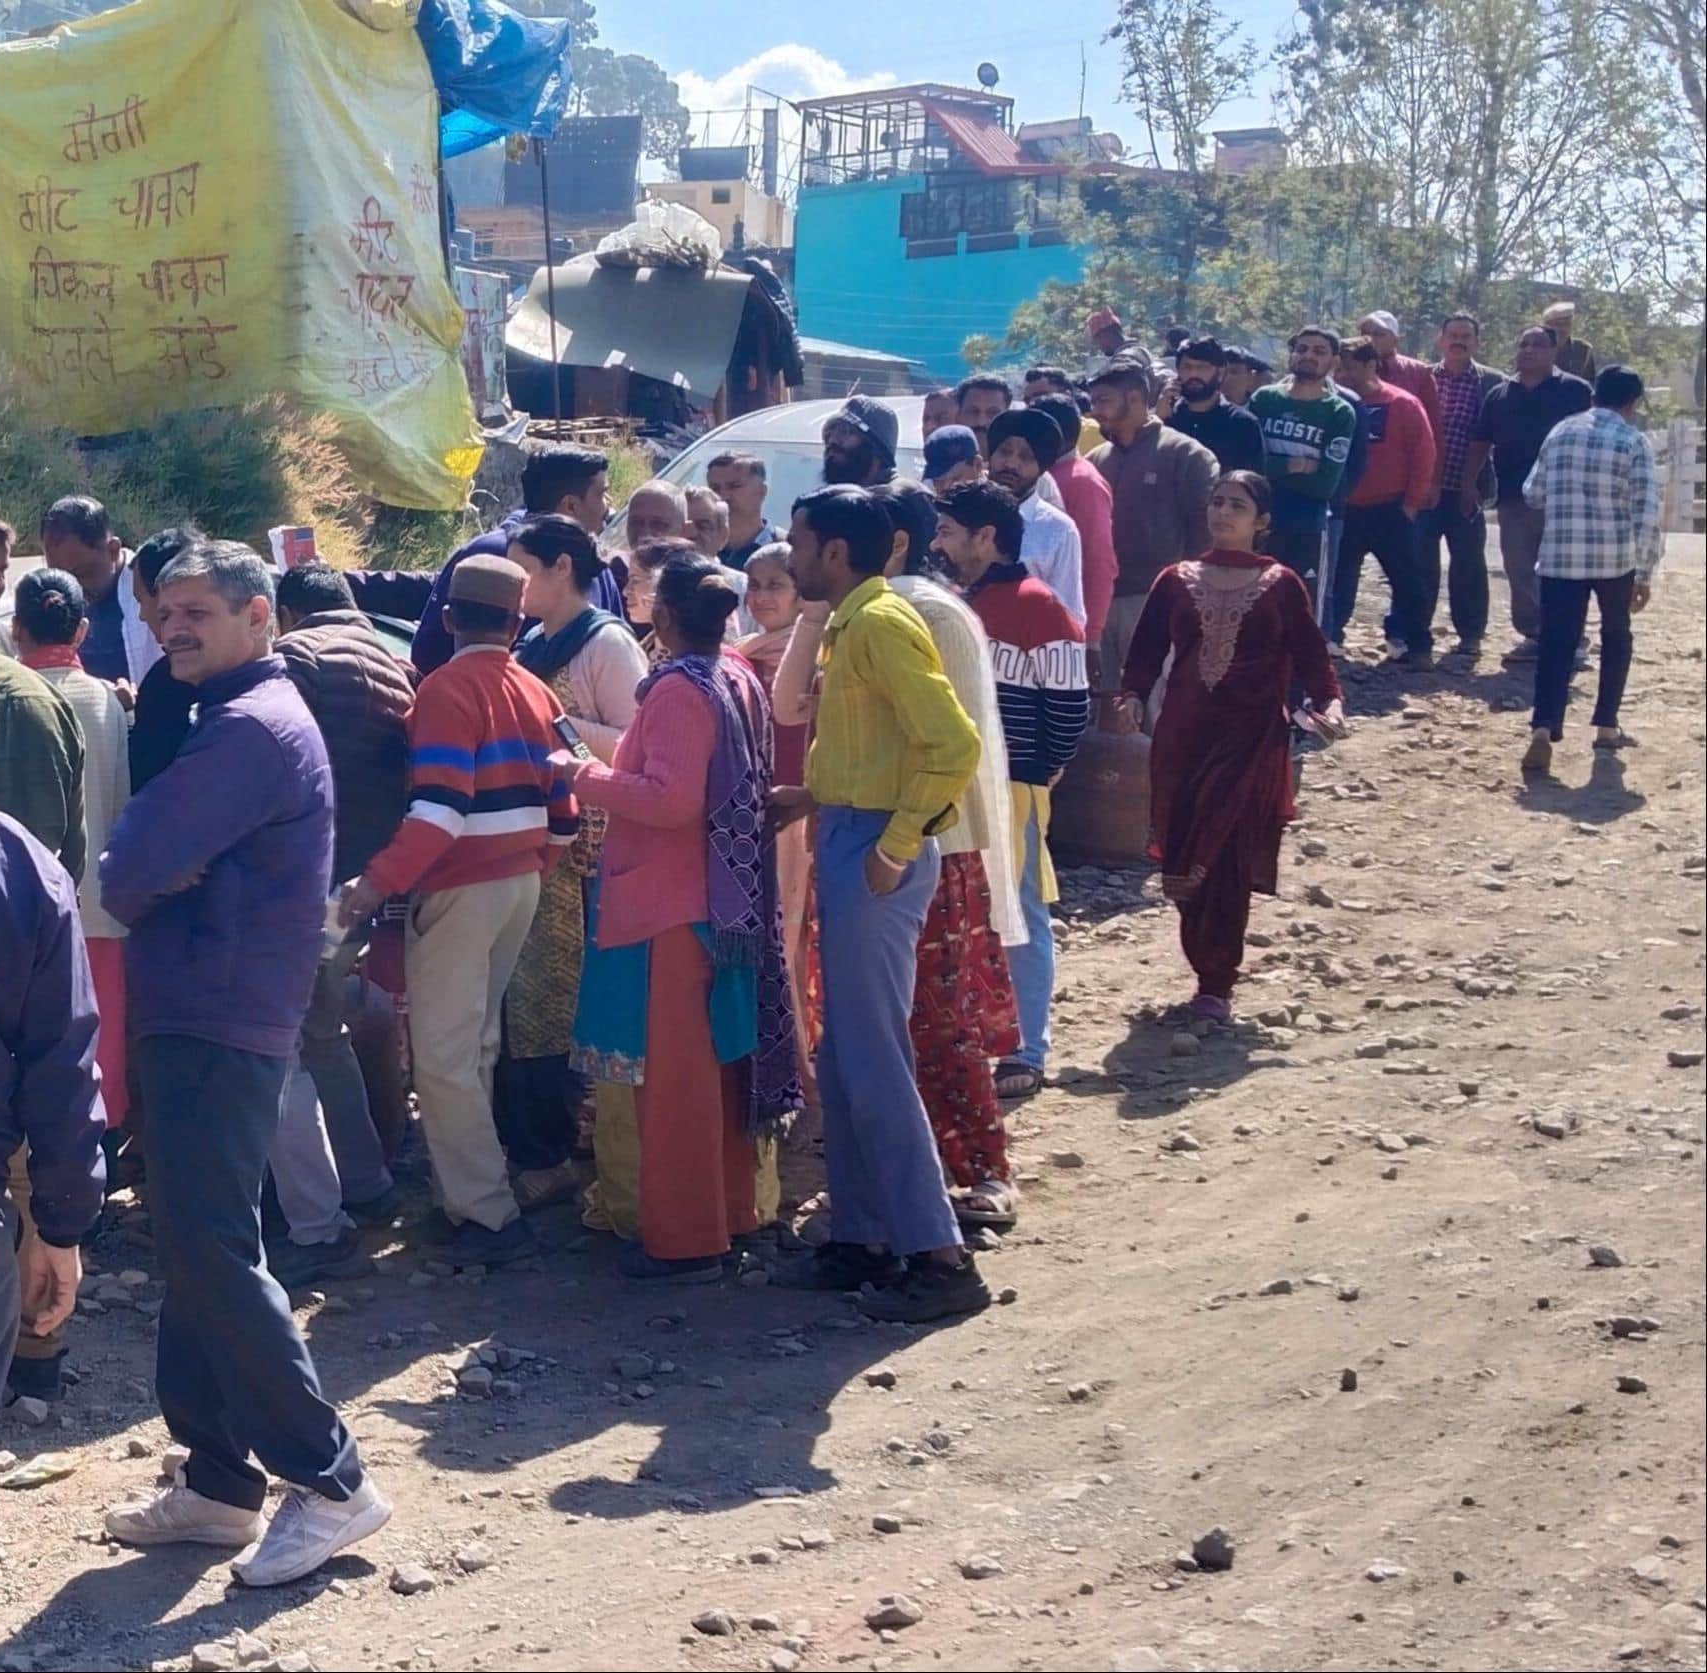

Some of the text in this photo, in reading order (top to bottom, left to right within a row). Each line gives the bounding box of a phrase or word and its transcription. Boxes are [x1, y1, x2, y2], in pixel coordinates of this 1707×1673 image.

[61, 93, 150, 163] मैगी
[109, 161, 201, 231] चावल
[136, 253, 230, 309] चावल
[1264, 418, 1325, 444] ACOSTE
